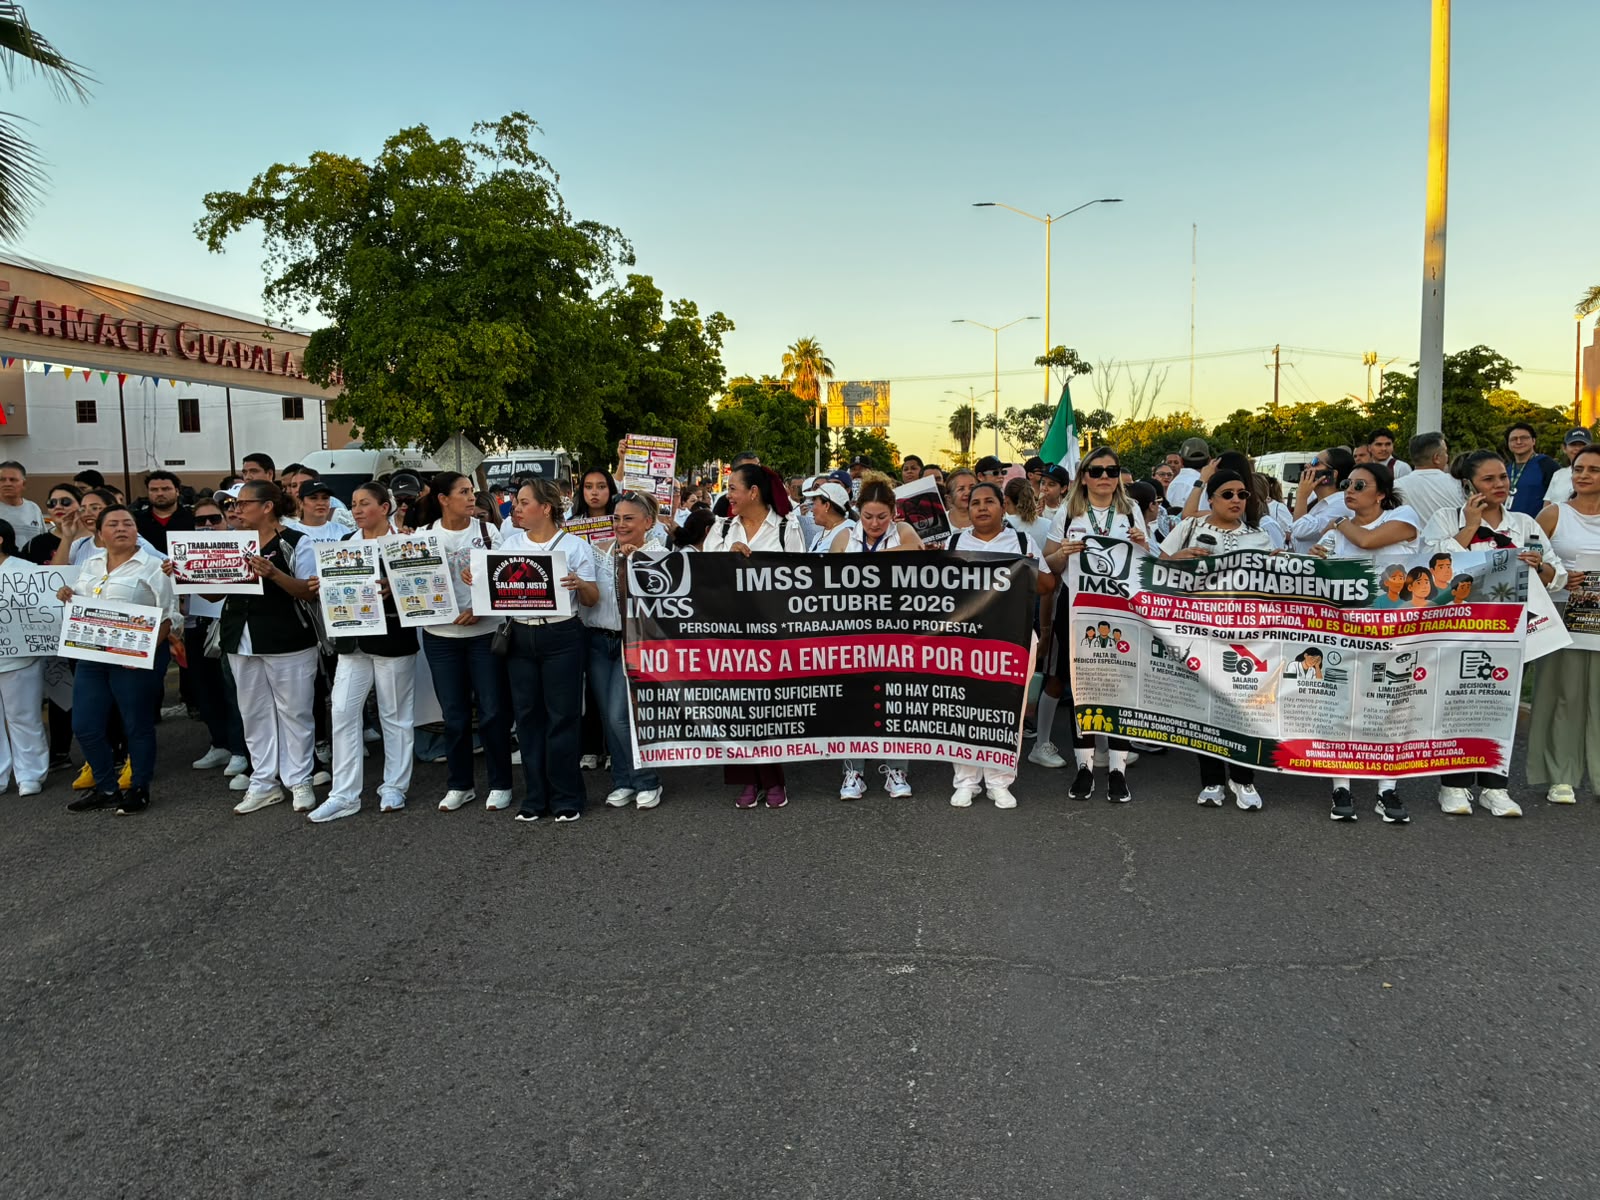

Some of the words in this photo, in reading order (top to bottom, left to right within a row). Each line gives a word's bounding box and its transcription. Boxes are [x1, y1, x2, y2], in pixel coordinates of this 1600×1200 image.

[187, 541, 239, 550] TRABAJADORES
[206, 559, 241, 569] UNIDAD!
[492, 560, 510, 582] SINALOA
[525, 558, 549, 582] PROTESTA
[1194, 560, 1209, 574] A
[1214, 552, 1316, 575] NUESTROS
[1491, 564, 1508, 574] IMSS
[495, 581, 526, 589] SALARIO
[526, 581, 548, 589] JUSTO
[735, 565, 813, 592] IMSS
[824, 565, 881, 589] LOS
[891, 565, 1012, 592] MOCHIS
[1078, 575, 1130, 599] IMSS
[1152, 564, 1369, 601] DERECHOHABIENTES
[626, 597, 695, 619] IMSS
[788, 594, 892, 614] OCTUBRE
[899, 594, 956, 613] 2026
[1141, 594, 1151, 605] SI
[1153, 596, 1173, 607] HOY
[1176, 598, 1189, 609] LA
[1191, 600, 1240, 613] ATENCIÓN
[1244, 603, 1256, 613] ES
[1259, 602, 1282, 614] MÁS
[1284, 604, 1318, 617] LENTA,
[1320, 608, 1340, 619] HAY
[1342, 610, 1381, 623] DÉFICIT
[1383, 612, 1398, 623] EN
[1400, 611, 1420, 623] LOS
[1421, 606, 1472, 620] SERVICIOS
[0, 605, 65, 625] OTEST
[1135, 605, 1149, 616] NO
[1150, 607, 1170, 618] HAY
[1172, 610, 1212, 624] ALGUIEN
[1215, 613, 1234, 625] QUE
[1237, 614, 1256, 626] LOS
[1259, 615, 1305, 629] ATIENDA,
[1307, 618, 1323, 629] NO
[1326, 621, 1340, 632] ES
[1342, 622, 1379, 636] CULPA
[1382, 625, 1395, 636] DE
[1397, 622, 1417, 635] LOS
[1419, 619, 1511, 632] TRABAJADORES.
[679, 622, 743, 634] PERSONAL
[746, 622, 778, 634] IMSS
[876, 619, 909, 630] BAJO
[1175, 624, 1209, 637] ESTAS
[1211, 628, 1236, 640] SON
[1238, 629, 1259, 640] LAS
[1262, 630, 1338, 646] PRINCIPALES
[1340, 637, 1393, 651] CAUSAS:
[640, 648, 669, 673] NO
[675, 648, 701, 673] TE
[706, 648, 772, 673] VAYAS
[778, 648, 793, 673] A
[799, 644, 915, 671] ENFERMAR
[921, 645, 964, 671] POR
[1098, 658, 1137, 668] ESPECIALISTAS
[1149, 660, 1167, 668] FALTA
[1156, 668, 1200, 683] MEDICAMENTOS
[1232, 676, 1259, 684] SALARIO
[637, 688, 654, 702] NO
[657, 688, 681, 702] HAY
[684, 687, 772, 701] MEDICAMENTO
[774, 684, 844, 700] SUFICIENTE
[886, 683, 901, 697] NO
[905, 683, 929, 697] HAY
[932, 685, 966, 700] CITAS
[1232, 683, 1258, 691] INDIGNO
[1297, 680, 1338, 691] SOBRECARGA
[1308, 688, 1336, 697] TRABAJO
[1378, 684, 1417, 692] LIMITACIONES
[637, 707, 654, 721] NO
[657, 706, 681, 720] HAY
[684, 705, 746, 720] PERSONAL
[748, 703, 817, 719] SUFICIENTE
[886, 701, 902, 714] NO
[905, 702, 929, 715] HAY
[932, 703, 1015, 725] PRESUPUESTO
[638, 726, 655, 740] NO
[657, 725, 682, 739] HAY
[685, 724, 727, 738] CAMAS
[729, 721, 805, 738] SUFICIENTES
[1119, 709, 1133, 718] LOS
[1134, 711, 1188, 729] TRABAJADORES
[1189, 722, 1202, 732] DEL
[1203, 725, 1221, 737] IMSS
[886, 719, 901, 733] SE
[903, 719, 966, 738] CANCELAN
[968, 726, 1019, 746] CIRUGÍAS
[1118, 716, 1150, 729] TAMBIÉN
[1151, 721, 1176, 733] SOMOS
[1176, 726, 1247, 753] DERECHOHABIENTES
[1118, 726, 1125, 735] Y
[1126, 727, 1168, 742] ESTAMOS
[1169, 735, 1189, 746] CON
[1190, 739, 1232, 757] USTEDES.
[639, 747, 702, 762] AUMENTO
[705, 746, 723, 760] DE
[726, 745, 783, 759] SALARIO
[786, 743, 824, 757] REAL,
[827, 742, 846, 753] NO
[850, 741, 879, 753] MAS
[883, 742, 932, 755] DINERO
[936, 744, 945, 756] A
[949, 745, 972, 759] LAS
[1312, 740, 1346, 750] NUESTRO
[1348, 742, 1383, 752] TRABAJO
[1385, 743, 1395, 752] ES
[1401, 739, 1430, 752] SEGUIRÁ
[1432, 739, 1457, 748] SIENDO
[1289, 758, 1311, 768] PERO
[1312, 759, 1365, 770] NECESITAMOS
[1366, 761, 1382, 770] LAS
[1383, 759, 1429, 771] CONDICIONES
[1430, 758, 1450, 767] PARA
[1451, 756, 1488, 766] HACERLO.
[1305, 749, 1336, 759] BRINDAR
[1337, 750, 1354, 759] UNA
[1355, 750, 1395, 762] ATENCIÓN
[1396, 751, 1415, 761] DIGNA
[1416, 751, 1421, 759] Y
[1422, 750, 1433, 759] DE
[1433, 748, 1466, 757] CALIDAD.
